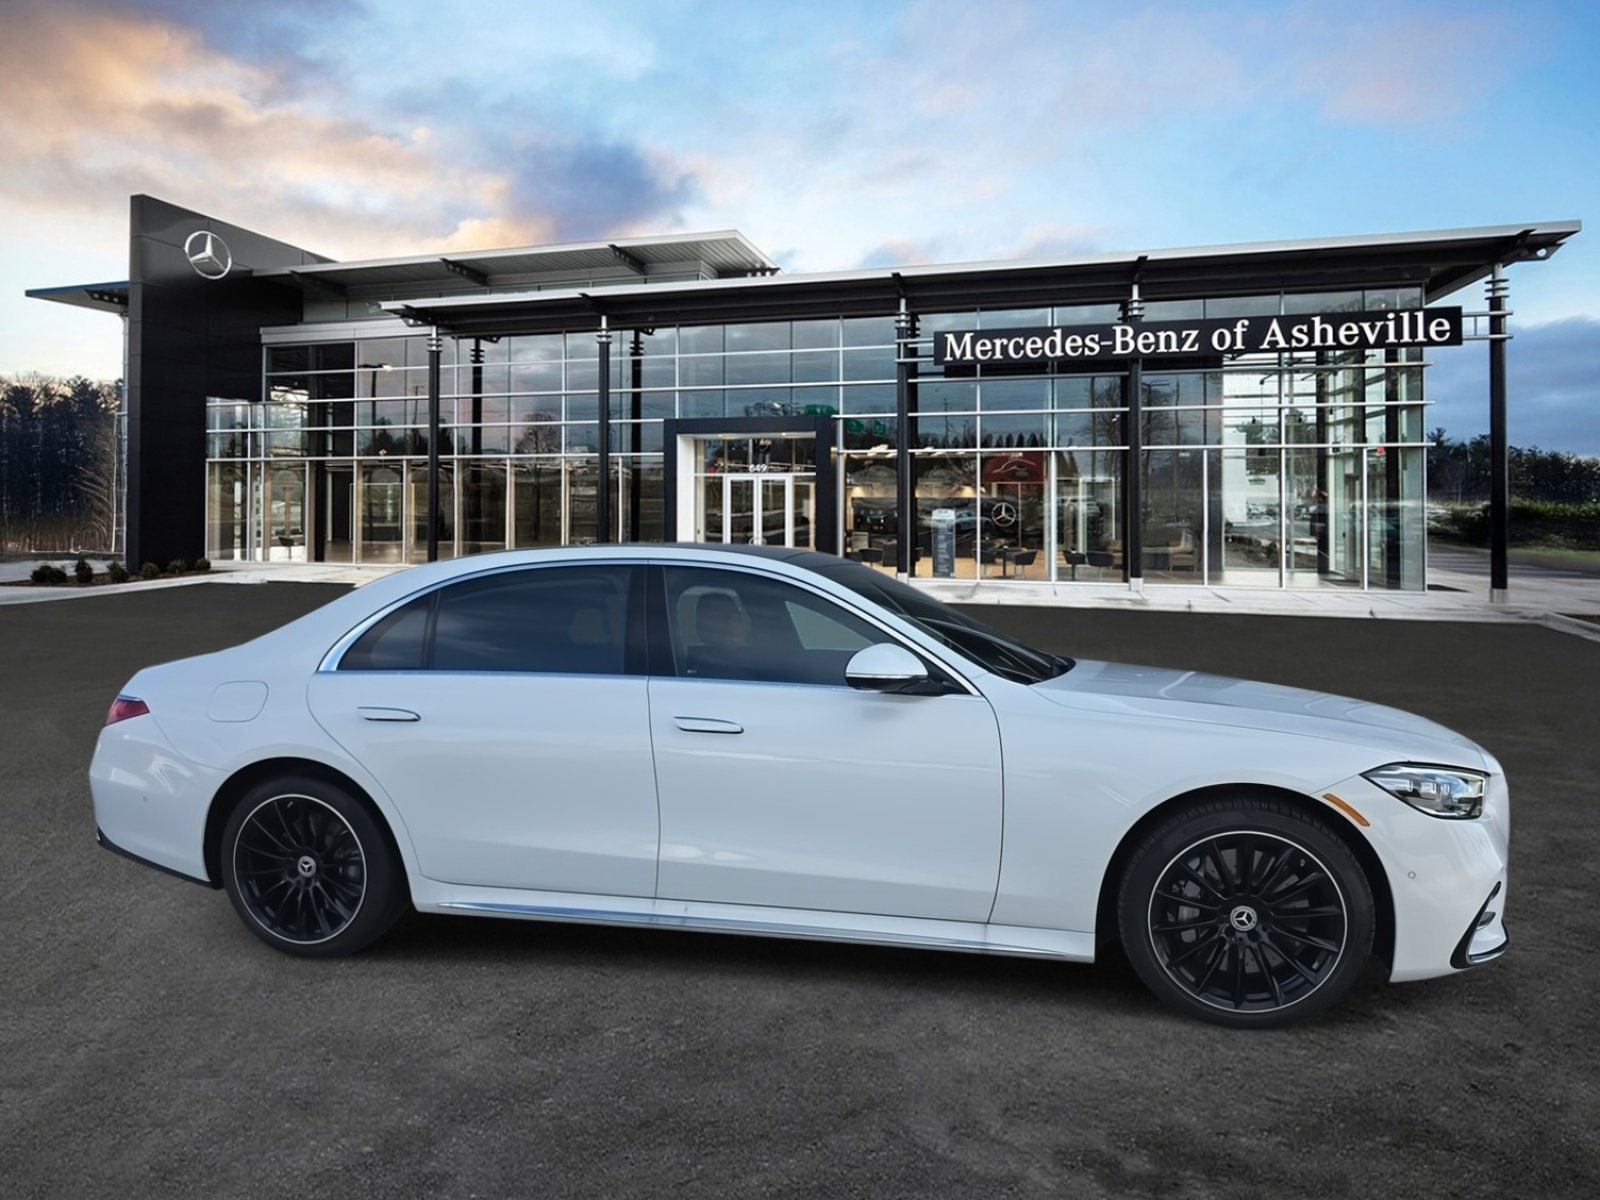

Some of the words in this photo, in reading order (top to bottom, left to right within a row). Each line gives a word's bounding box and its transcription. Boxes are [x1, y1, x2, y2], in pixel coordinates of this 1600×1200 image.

[944, 325, 1199, 361] Mercedes-Benz
[1211, 319, 1249, 351] of
[1259, 311, 1451, 349] Asheville
